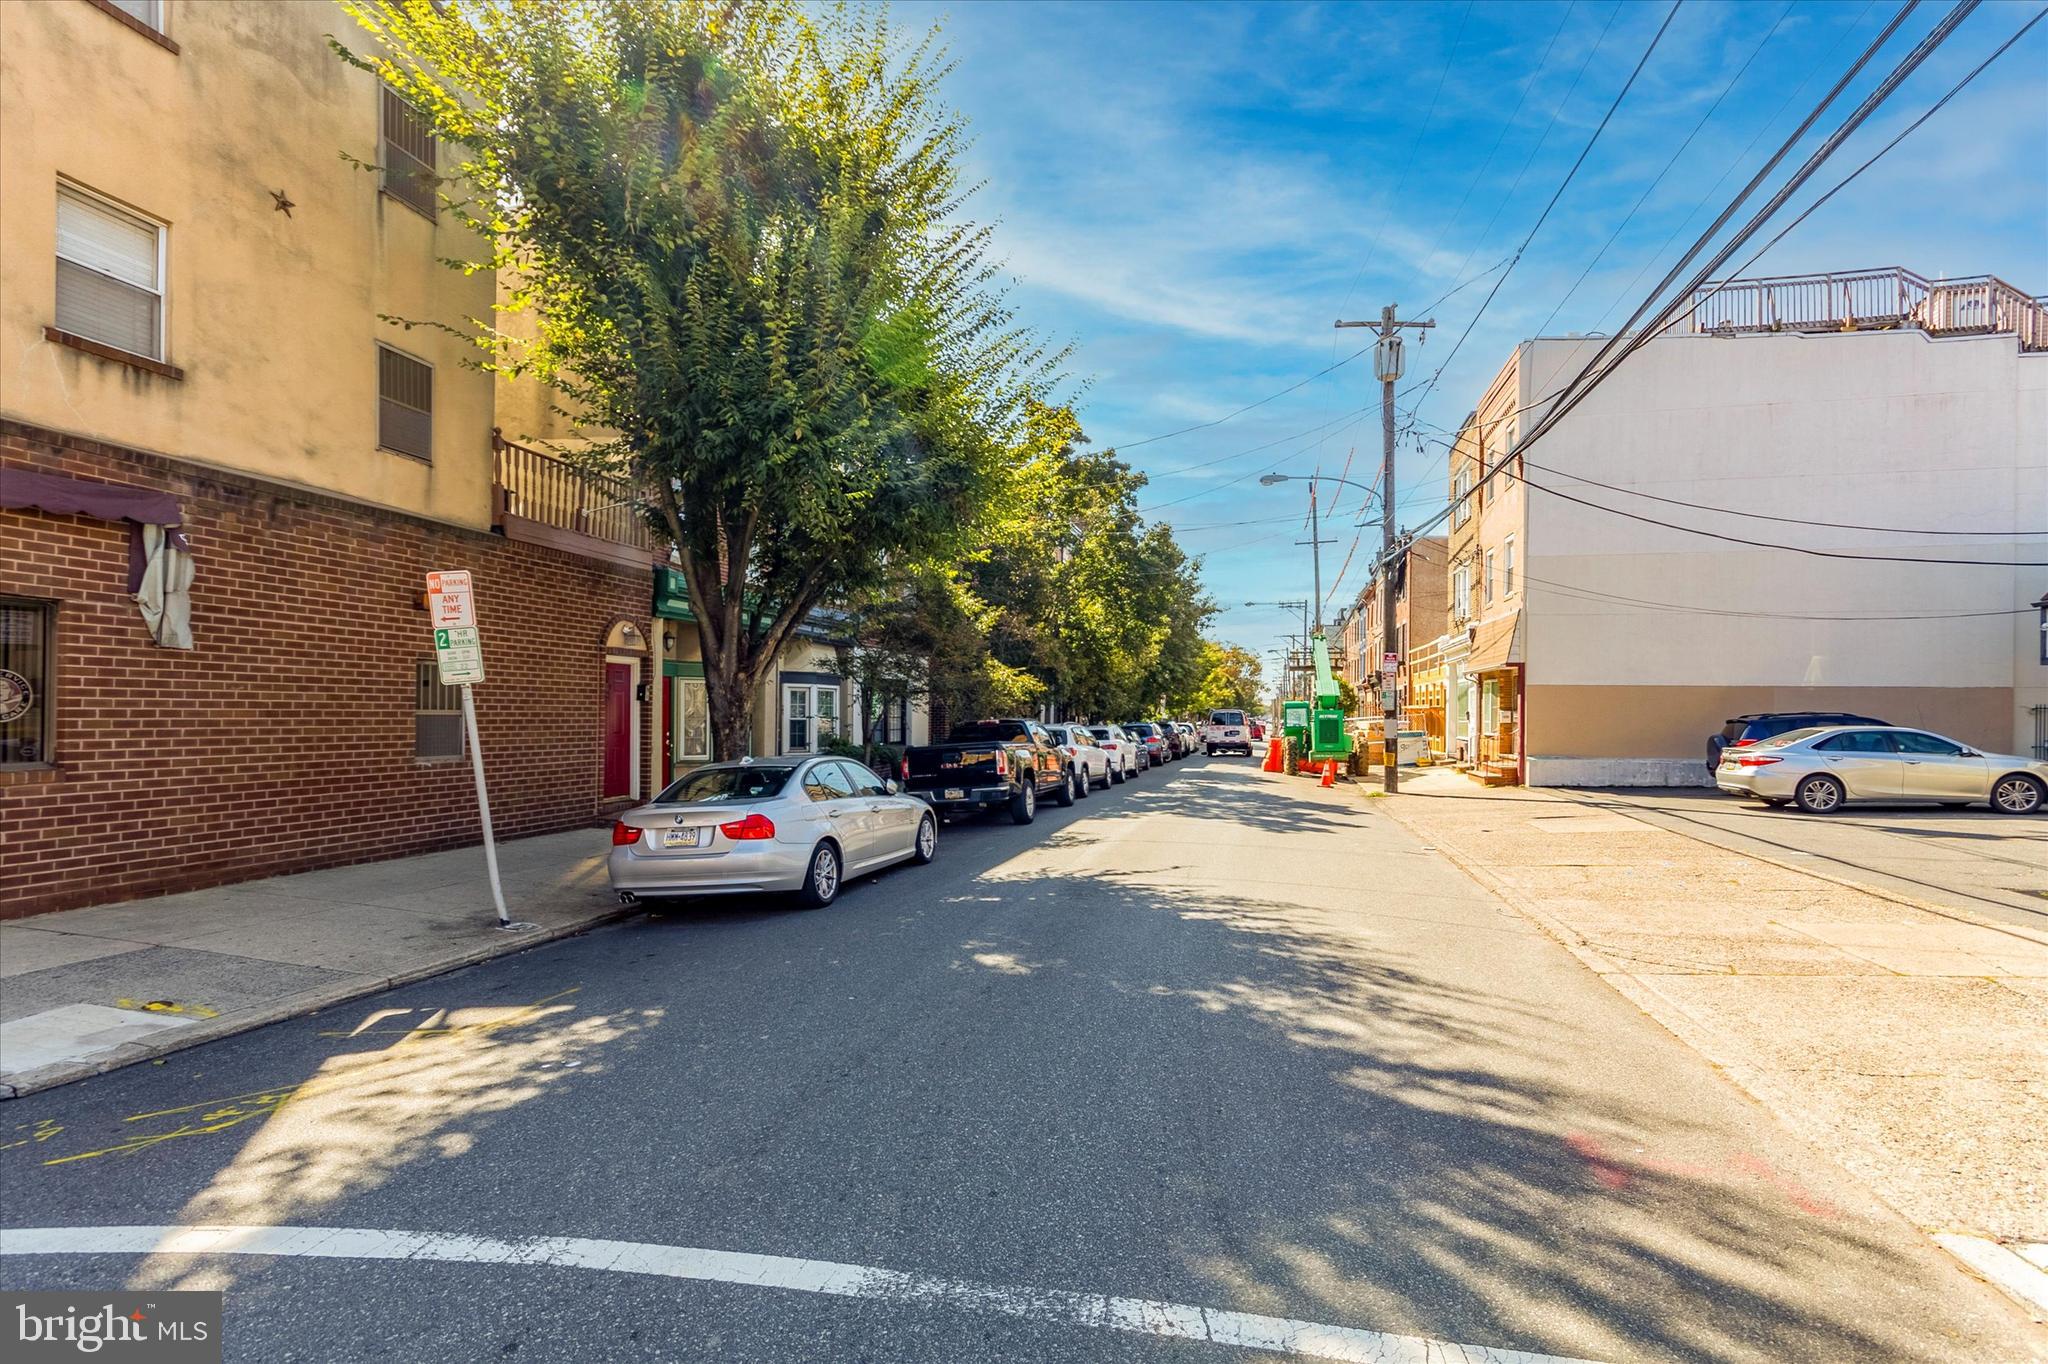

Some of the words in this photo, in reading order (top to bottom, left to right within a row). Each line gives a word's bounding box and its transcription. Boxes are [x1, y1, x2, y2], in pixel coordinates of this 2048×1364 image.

[442, 594, 459, 604] ANY
[442, 604, 462, 614] TIME
[438, 632, 448, 647] 2
[450, 638, 476, 647] PARKING
